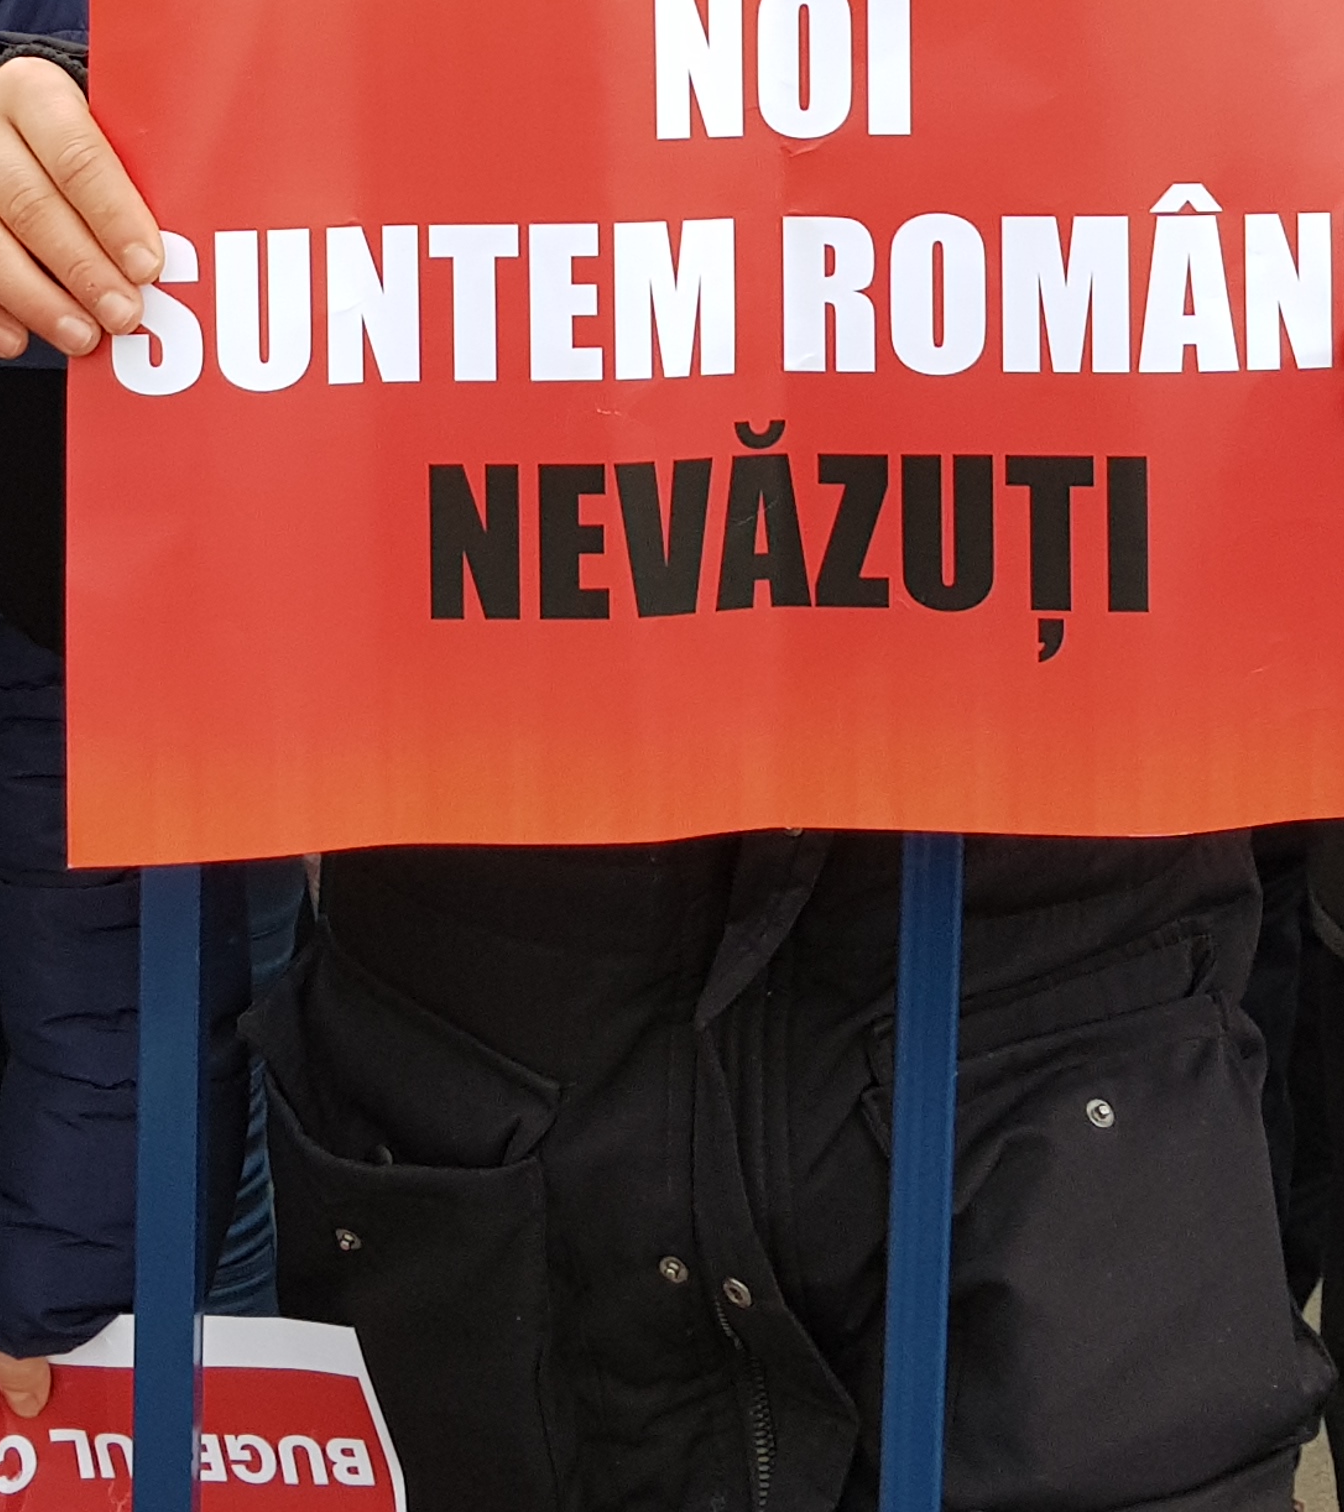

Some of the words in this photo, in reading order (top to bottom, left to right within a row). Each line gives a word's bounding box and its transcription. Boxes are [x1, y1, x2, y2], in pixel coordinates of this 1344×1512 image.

[112, 219, 736, 396] SUNTEM
[429, 419, 1149, 663] NEVĂZUȚI
[49, 1428, 376, 1486] BUGEUL
